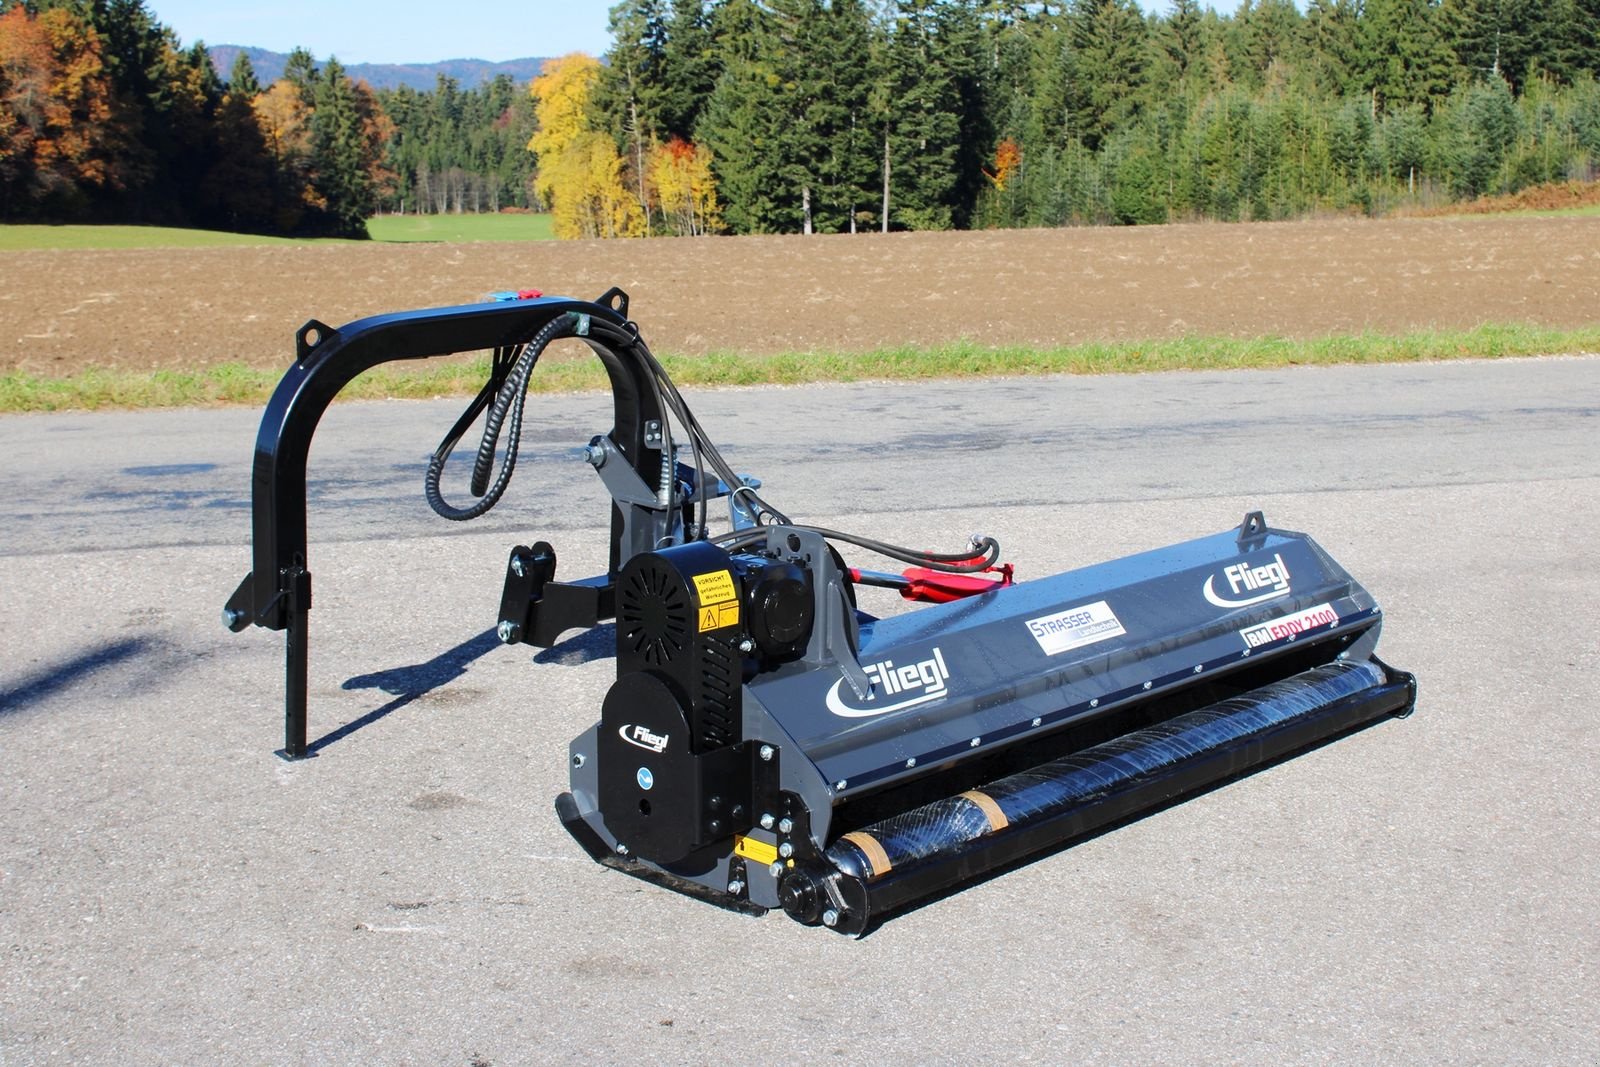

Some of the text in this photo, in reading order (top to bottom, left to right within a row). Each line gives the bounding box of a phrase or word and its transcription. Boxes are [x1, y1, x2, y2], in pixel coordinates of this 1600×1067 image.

[698, 575, 724, 585] VORSICHT
[1223, 553, 1290, 594] Fliegl
[1271, 619, 1305, 640] EDDY
[1305, 609, 1336, 630] 2100
[862, 647, 949, 700] Fliegl
[633, 725, 669, 751] Fliegl
